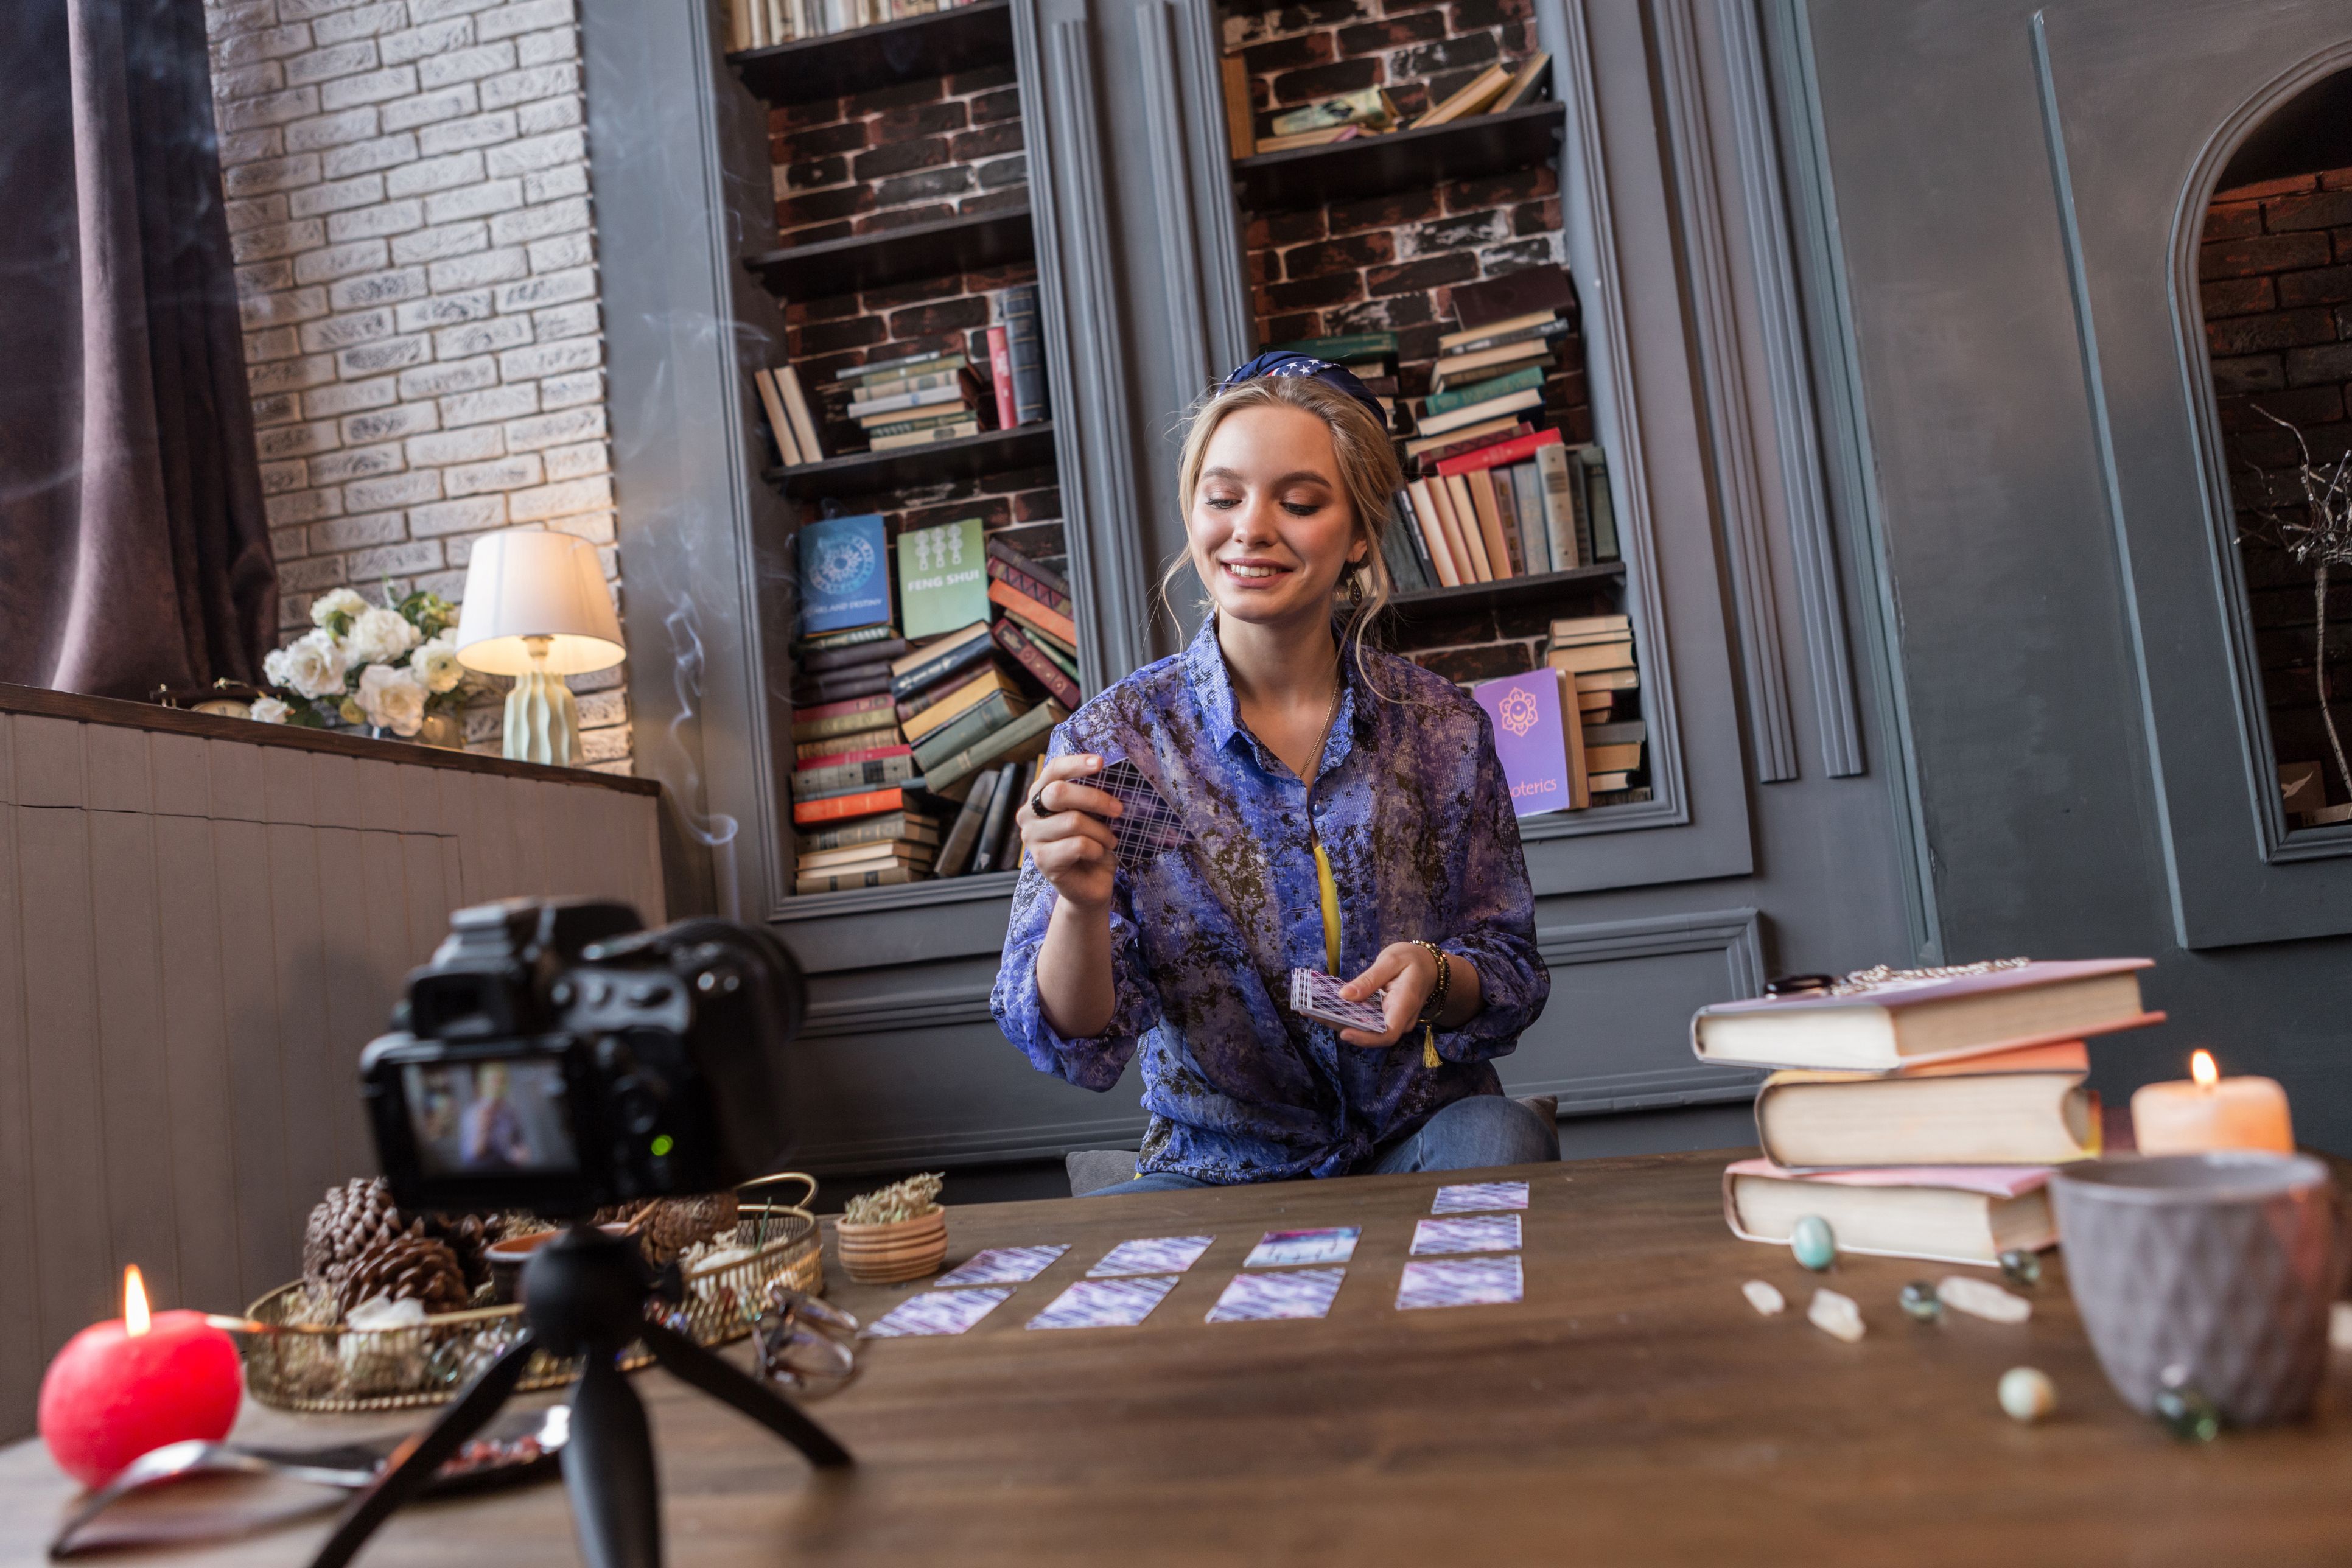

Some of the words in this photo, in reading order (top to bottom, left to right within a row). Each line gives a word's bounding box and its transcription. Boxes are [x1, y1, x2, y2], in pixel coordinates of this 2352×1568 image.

[908, 576, 943, 592] FENG
[947, 570, 979, 585] SHUI
[849, 598, 881, 609] DESTINY
[1510, 779, 1557, 798] oterics
